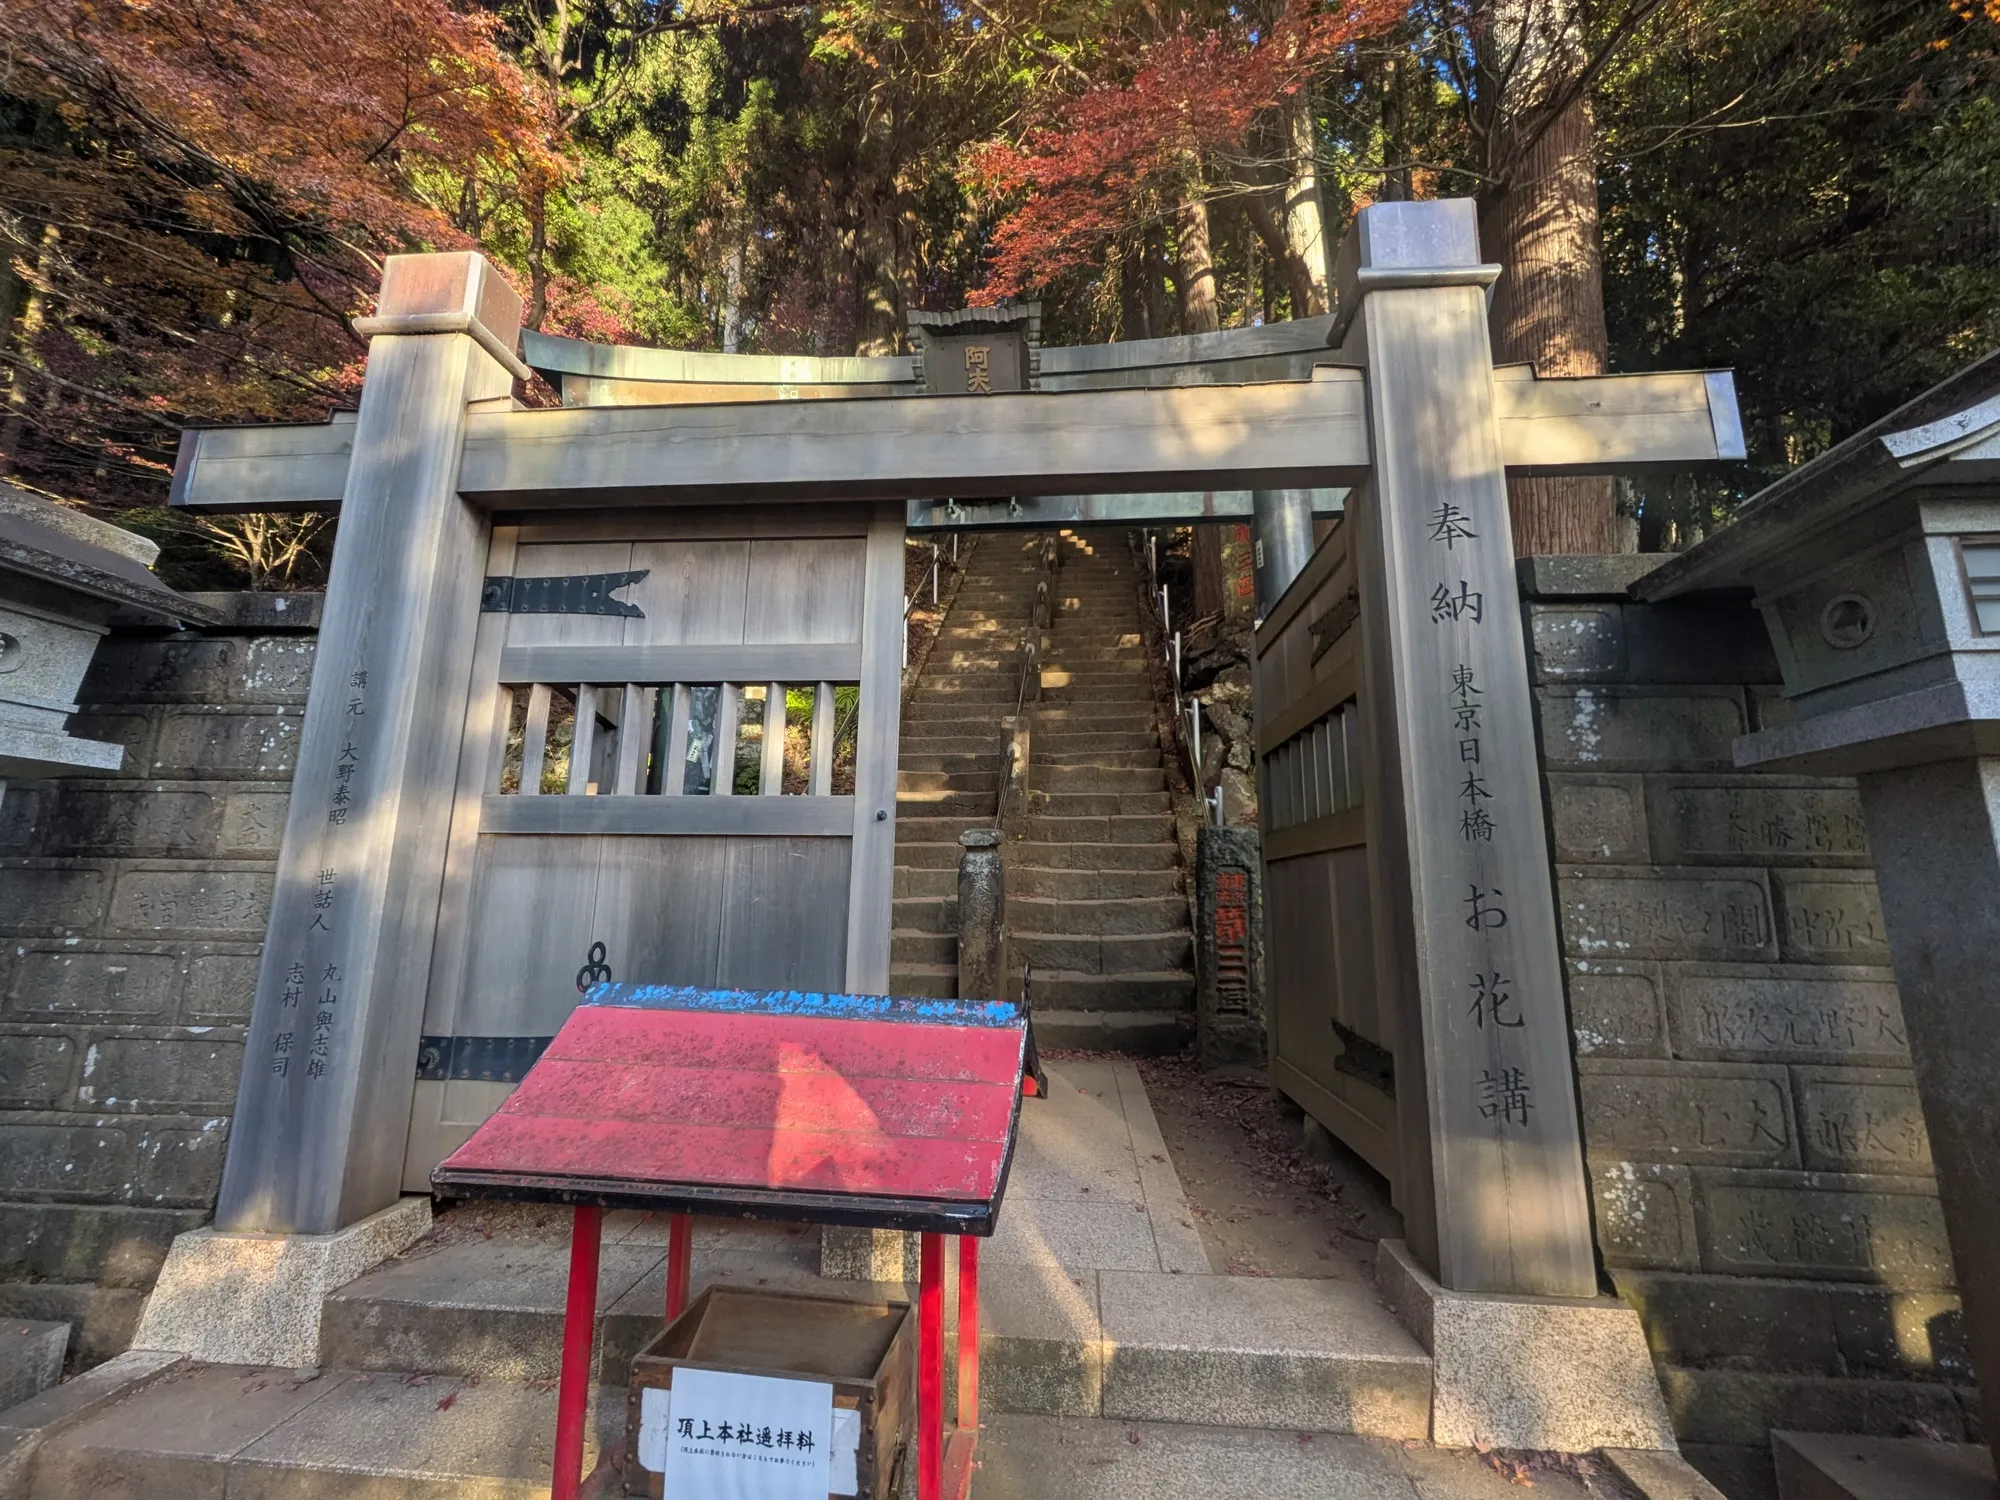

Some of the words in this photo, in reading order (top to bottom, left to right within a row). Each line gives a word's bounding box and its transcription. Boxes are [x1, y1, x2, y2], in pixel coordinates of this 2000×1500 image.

[1426, 502, 1484, 625] 奉納
[346, 671, 369, 717] 講元
[1449, 664, 1497, 843] 東京日本橋
[328, 742, 359, 826] 大野泰昭
[309, 869, 338, 933] 世話人
[305, 962, 342, 1081] 丸山與志雄
[1464, 884, 1535, 1128] お花講
